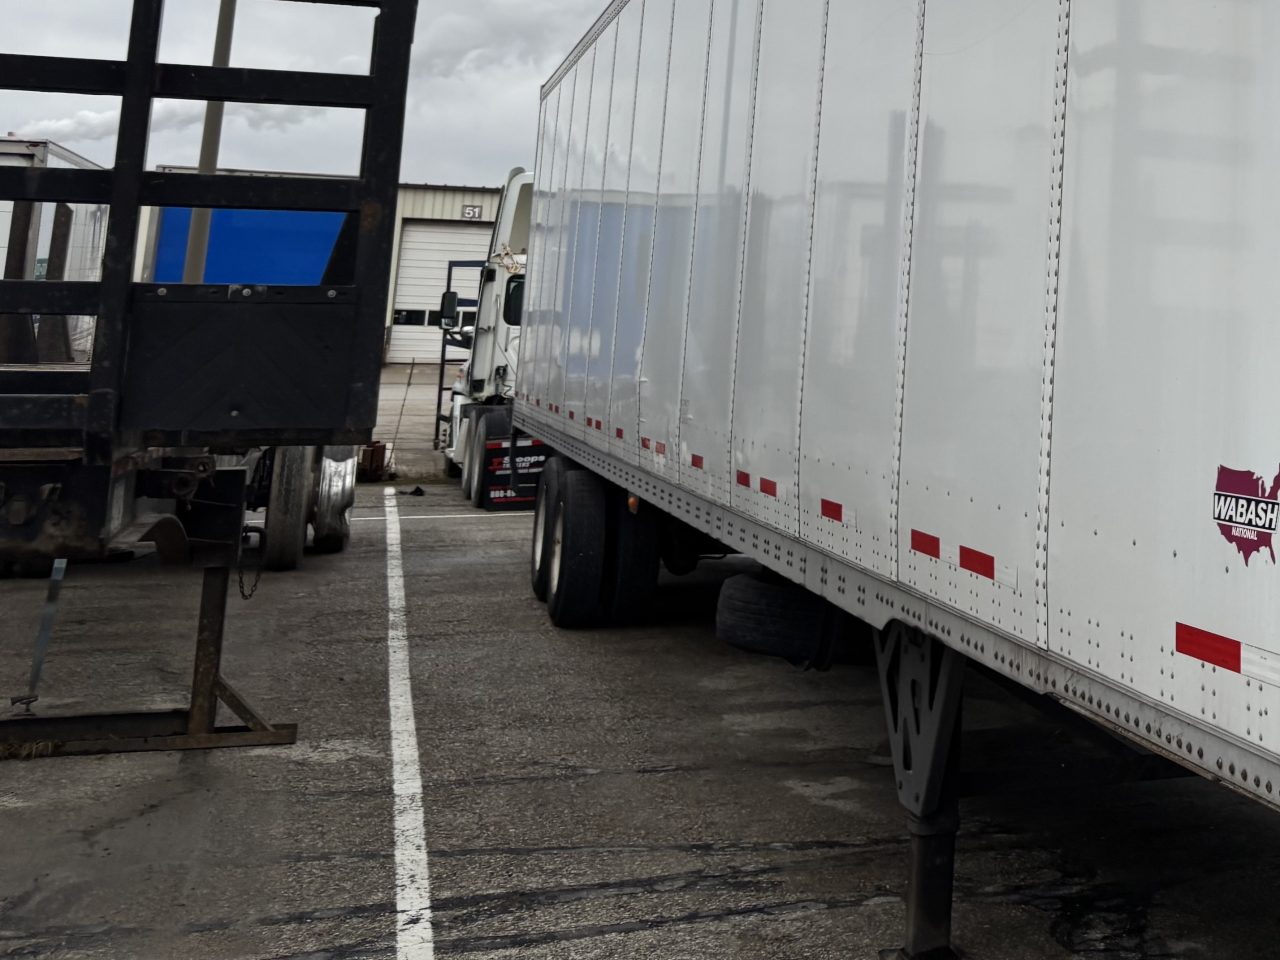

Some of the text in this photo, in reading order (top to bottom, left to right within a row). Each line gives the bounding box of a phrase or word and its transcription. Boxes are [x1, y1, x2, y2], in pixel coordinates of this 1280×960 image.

[465, 207, 479, 218] 51
[502, 455, 545, 463] Soops
[1214, 495, 1279, 529] WABASH
[1232, 527, 1258, 541] NATIONAL
